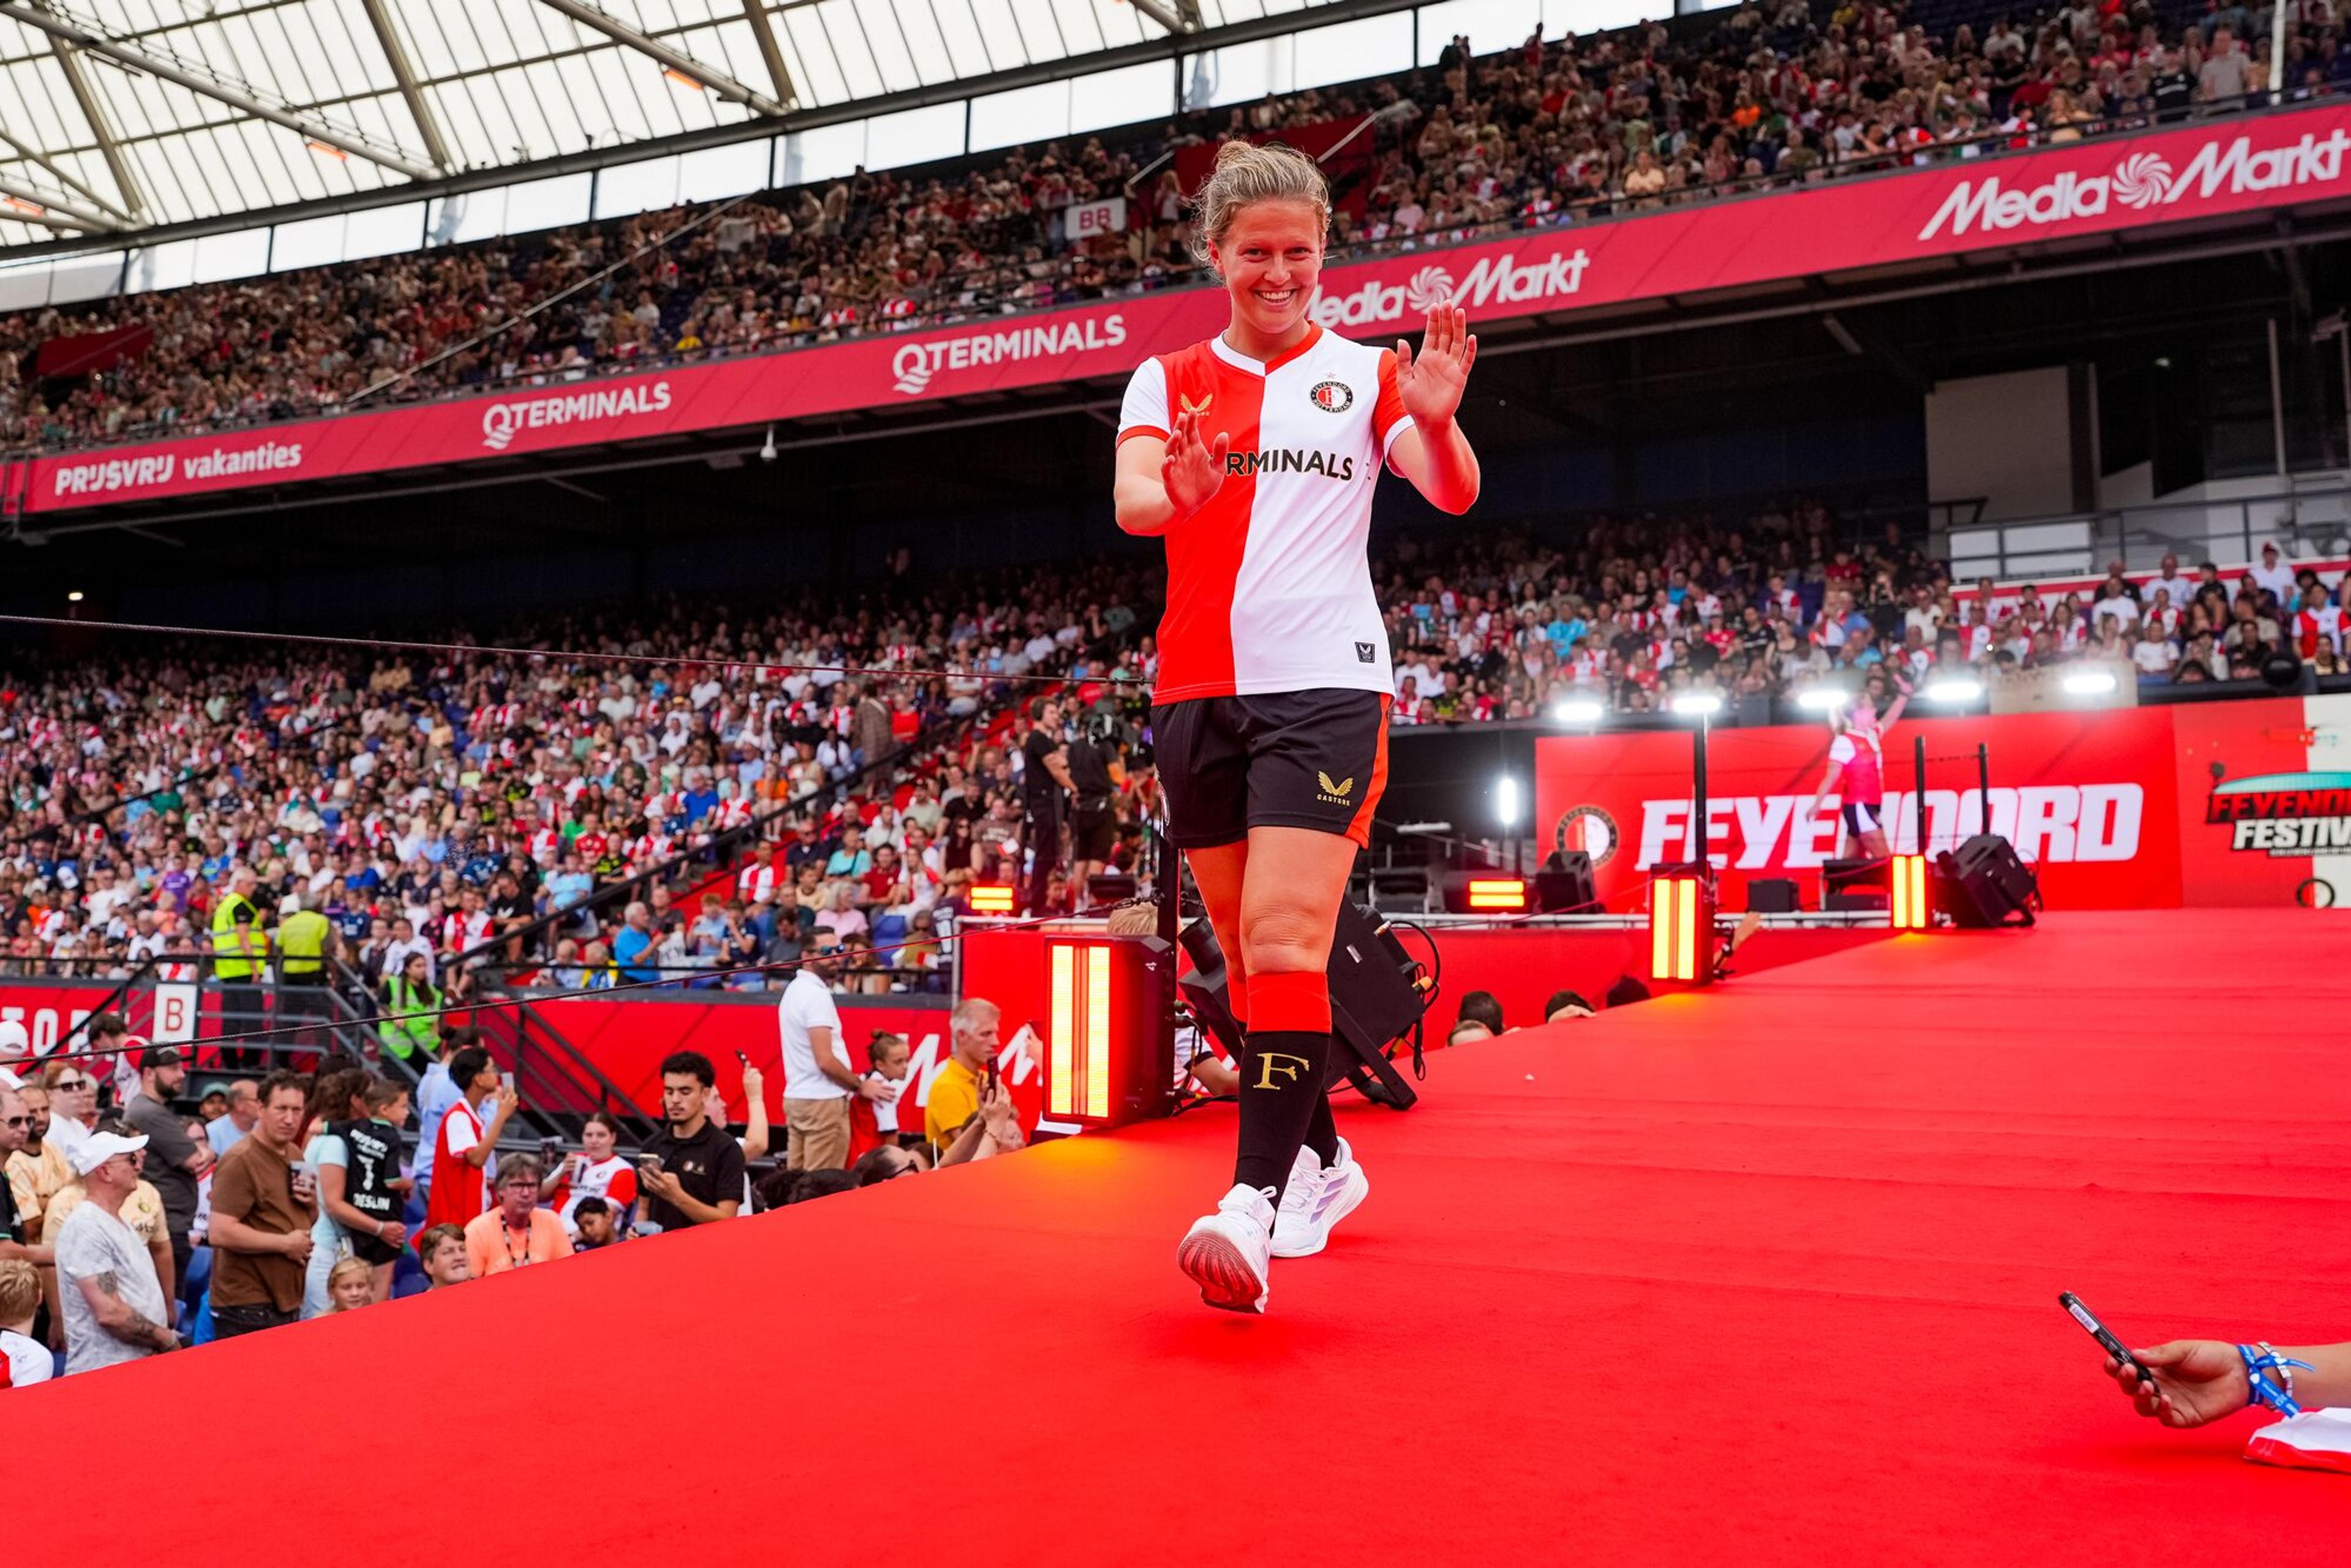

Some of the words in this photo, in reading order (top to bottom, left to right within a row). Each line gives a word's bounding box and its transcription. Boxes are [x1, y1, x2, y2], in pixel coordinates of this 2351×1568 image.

[1918, 171, 2110, 241] Media
[2162, 129, 2351, 204] Markt
[1307, 280, 1407, 329] edia
[1452, 249, 1591, 307] Markt
[893, 315, 1127, 395] QTERMINALS
[482, 382, 672, 450] QTERMINALS
[184, 441, 302, 479] vakanties
[1226, 449, 1354, 481] RMINALS
[2208, 788, 2351, 822] FEYENO
[2232, 816, 2351, 850] FESTIV
[164, 997, 184, 1032] B
[1253, 1052, 1310, 1090] F
